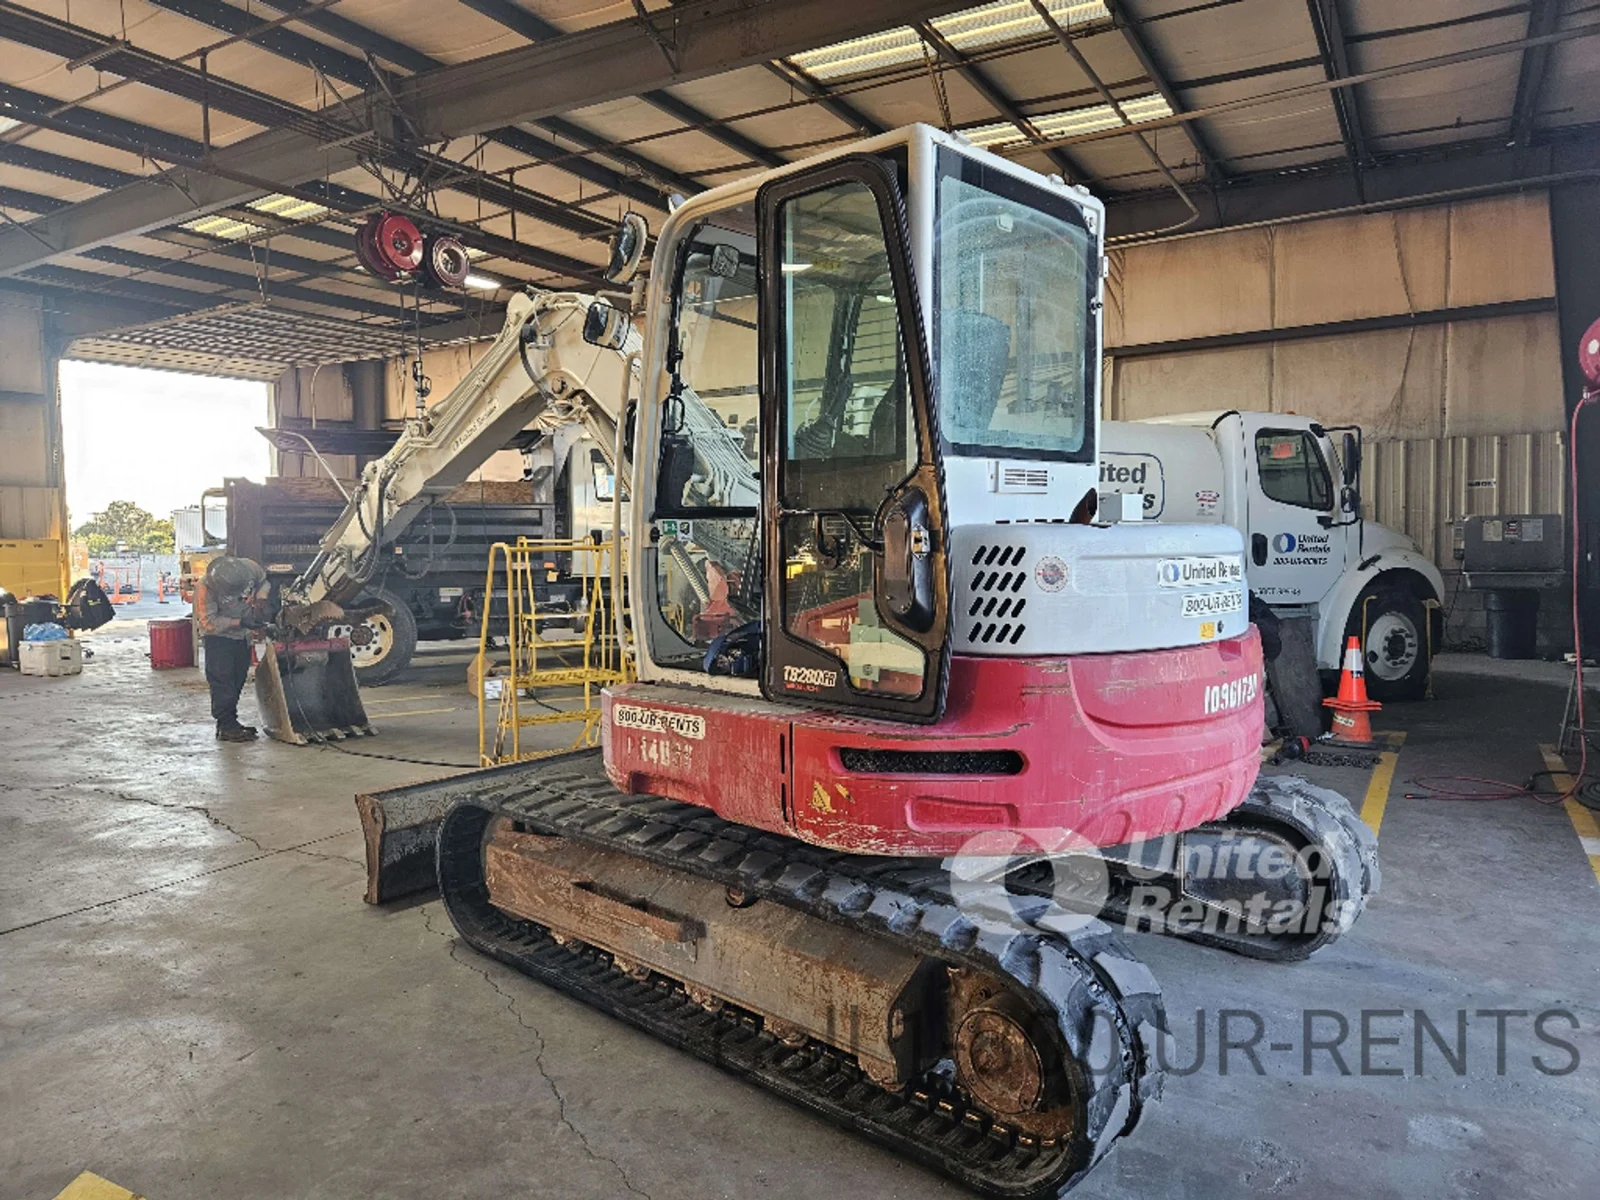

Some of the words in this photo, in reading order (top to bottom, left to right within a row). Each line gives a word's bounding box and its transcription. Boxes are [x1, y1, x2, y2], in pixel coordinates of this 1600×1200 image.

[1099, 461, 1147, 484] ited
[1182, 561, 1217, 580] United
[618, 709, 700, 734] 800-UR-RENTS
